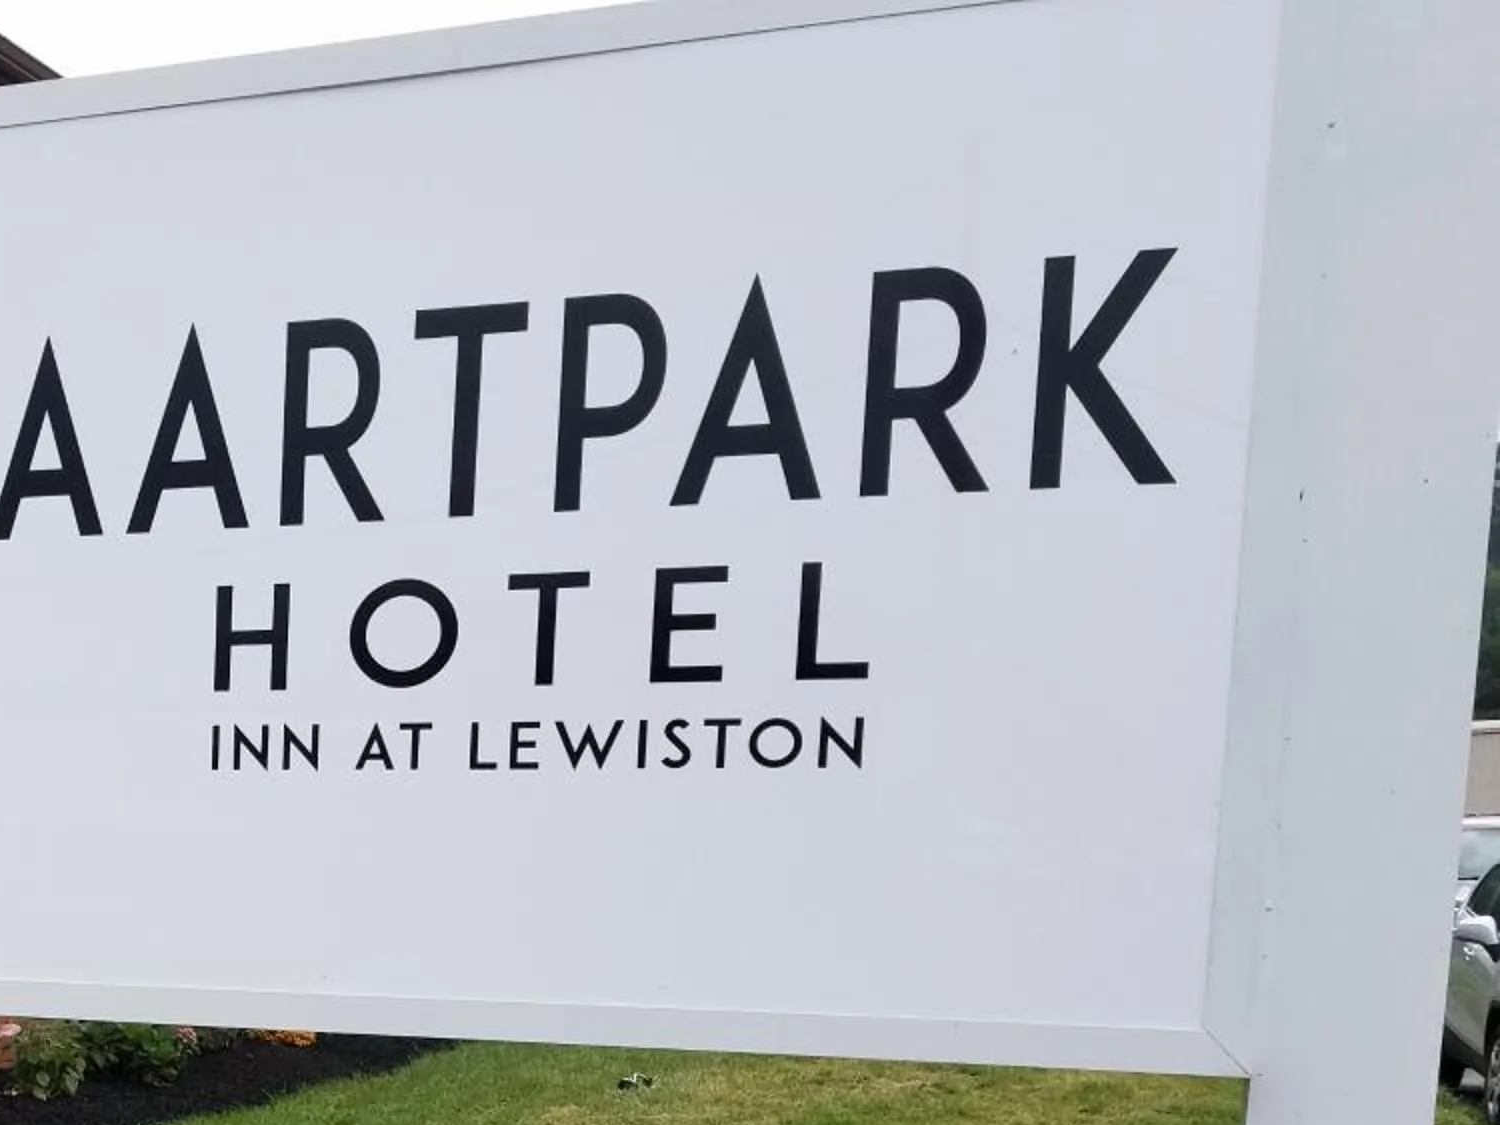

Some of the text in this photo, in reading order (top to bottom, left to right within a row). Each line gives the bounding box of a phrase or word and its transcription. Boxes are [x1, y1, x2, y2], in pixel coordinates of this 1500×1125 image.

[212, 560, 870, 693] HOTEL
[210, 715, 866, 772] INN AT LEWISTON
